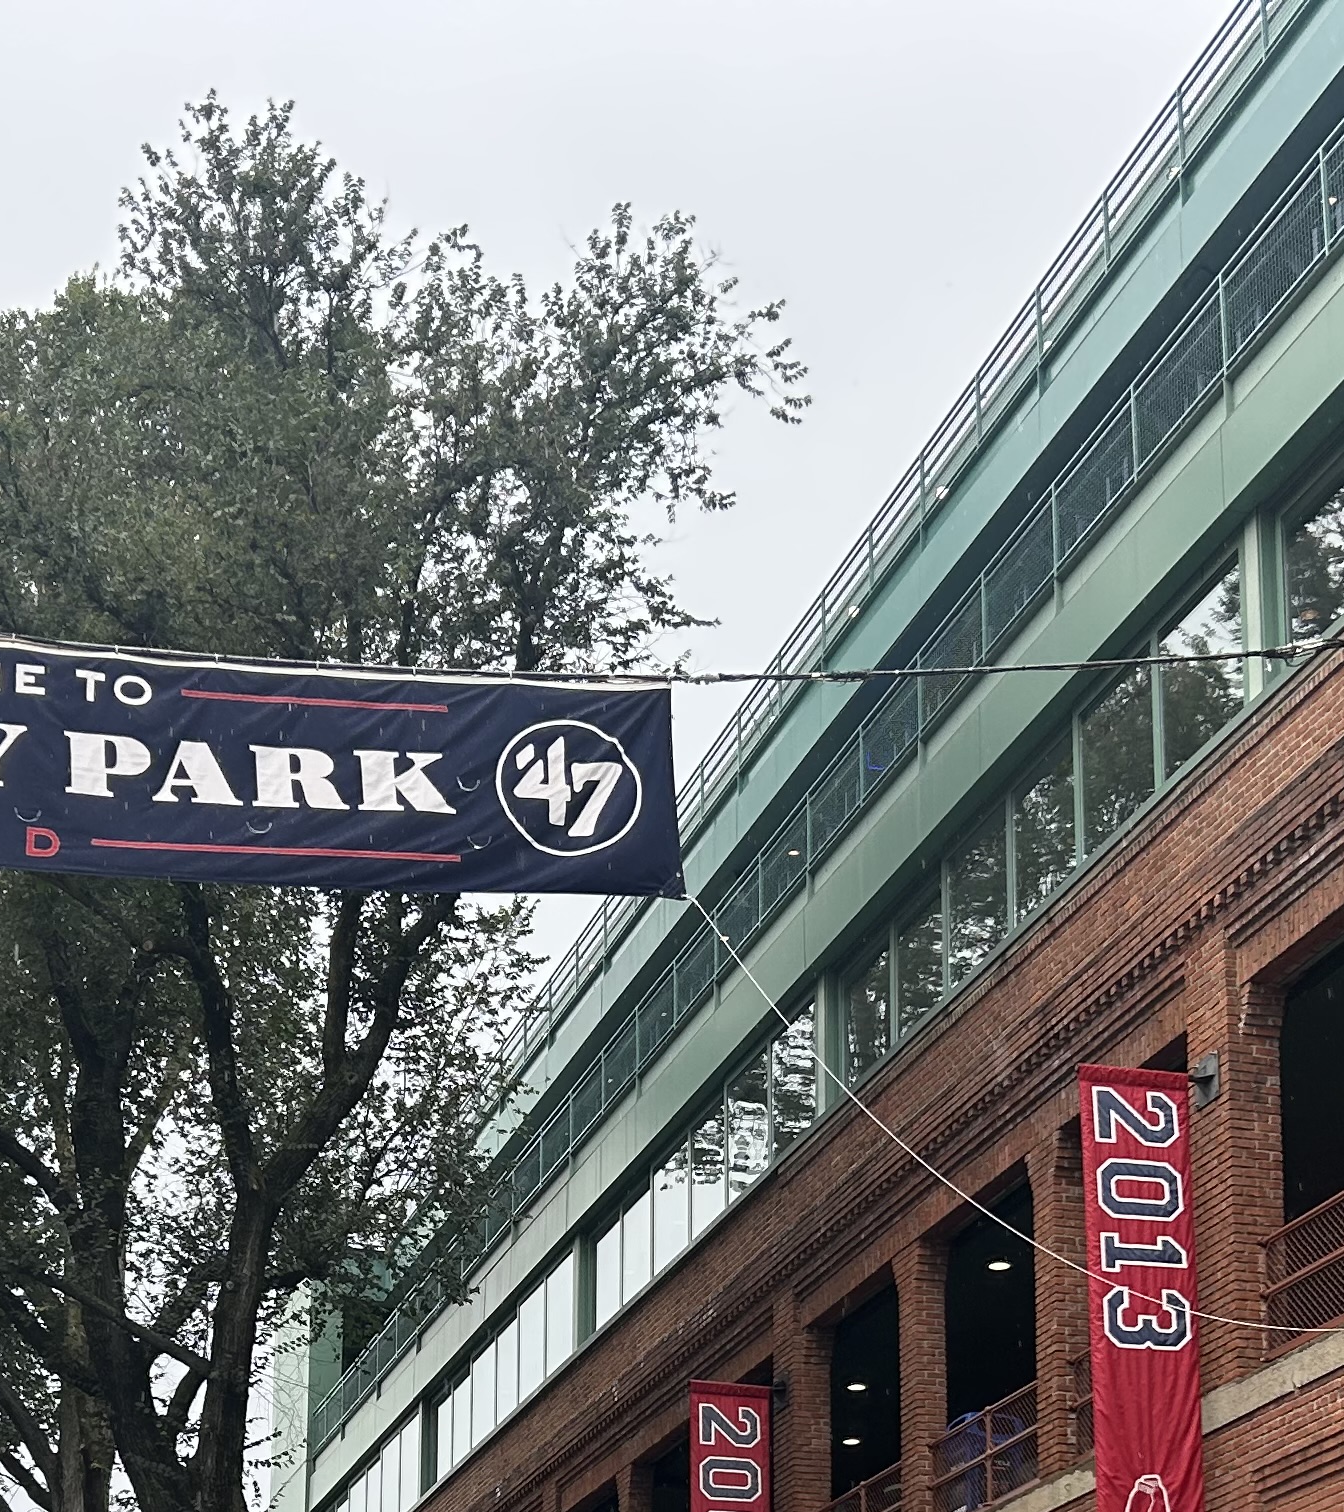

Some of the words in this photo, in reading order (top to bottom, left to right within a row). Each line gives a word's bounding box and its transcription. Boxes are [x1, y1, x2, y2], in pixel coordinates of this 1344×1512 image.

[75, 668, 152, 707] TO
[63, 730, 457, 817] PARK
[25, 825, 61, 858] D
[1090, 1084, 1193, 1351] 2013
